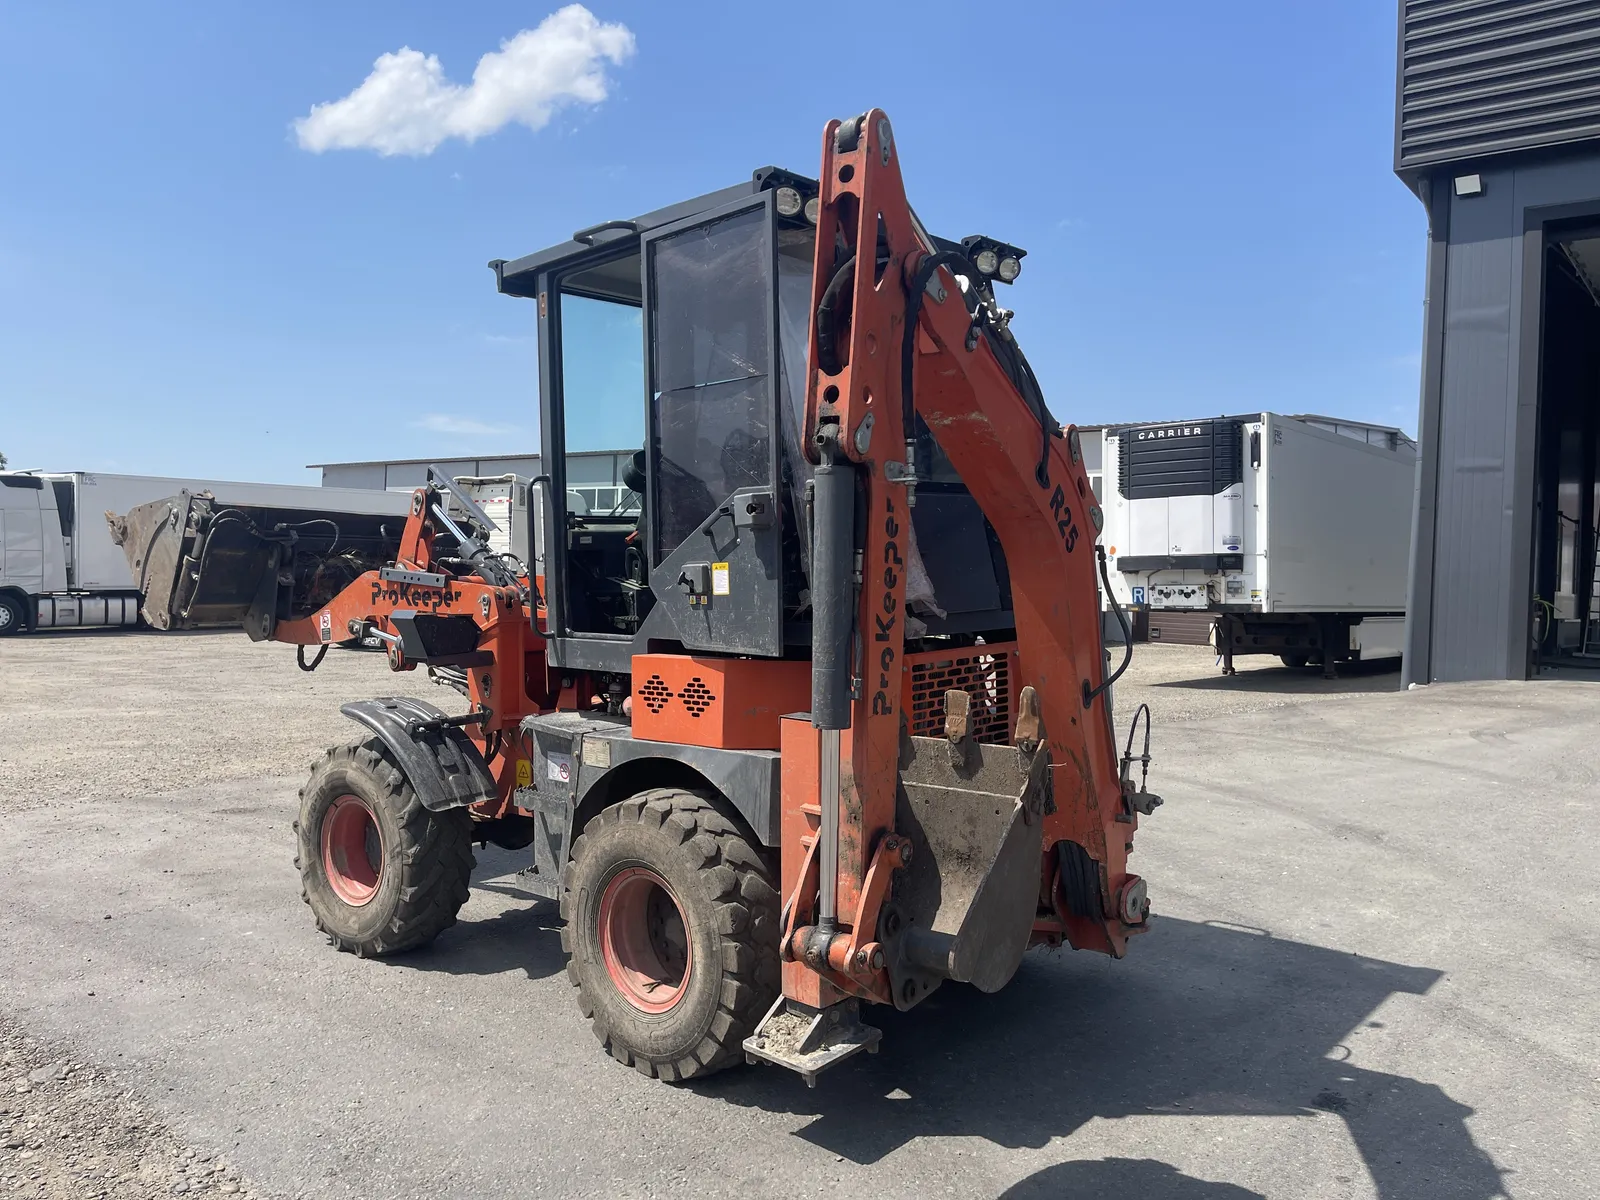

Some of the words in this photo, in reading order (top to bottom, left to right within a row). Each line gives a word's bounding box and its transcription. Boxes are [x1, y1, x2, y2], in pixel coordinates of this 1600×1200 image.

[1138, 427, 1201, 440] CARRIER
[1049, 483, 1079, 553] R25
[371, 582, 462, 613] ProKeeper
[873, 497, 902, 716] ProKeeper
[1133, 588, 1144, 602] R
